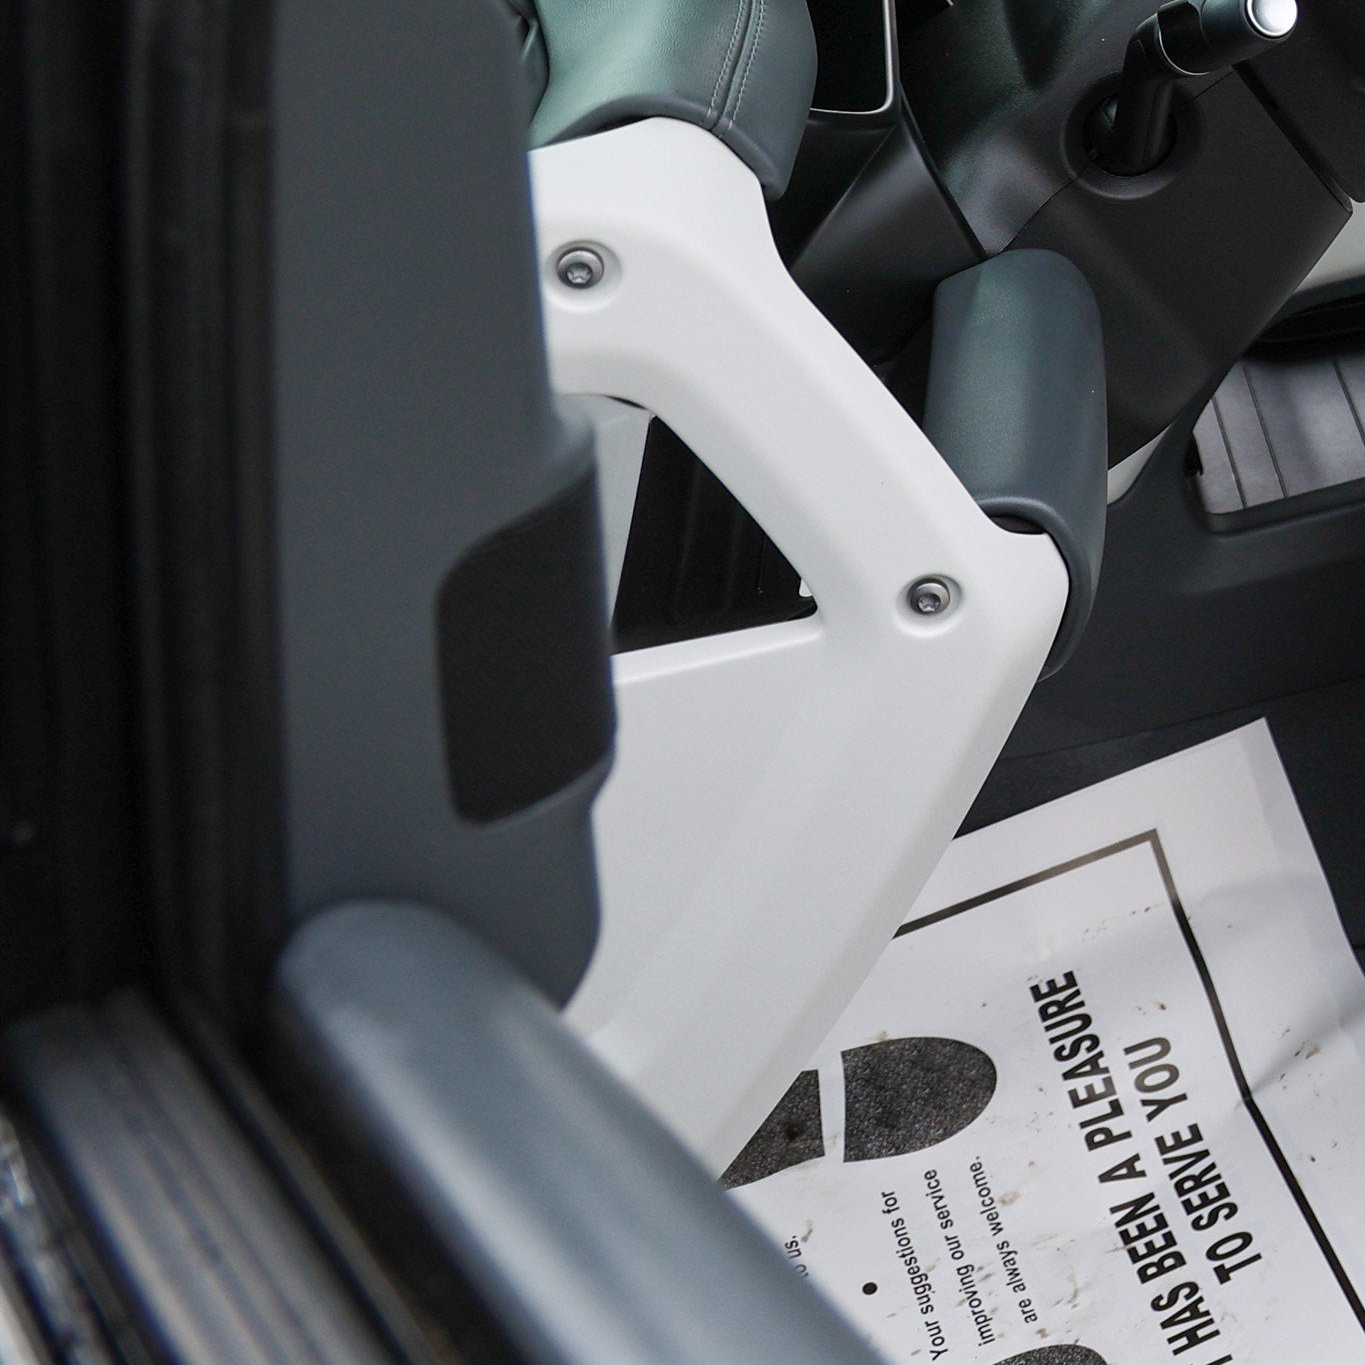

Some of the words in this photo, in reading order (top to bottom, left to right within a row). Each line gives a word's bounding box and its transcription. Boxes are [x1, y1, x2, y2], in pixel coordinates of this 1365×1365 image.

[1029, 970, 1133, 1152] PLEASURE
[1123, 1037, 1188, 1123] YOU
[969, 1156, 1004, 1236] welcome.
[1098, 1152, 1147, 1184] A
[1155, 1123, 1239, 1232] SERVE
[881, 1191, 900, 1215] for
[924, 1169, 954, 1230] service
[785, 1235, 803, 1259] us.
[891, 1217, 936, 1315] suggestions
[945, 1235, 965, 1261] our
[996, 1240, 1026, 1294] always
[1109, 1191, 1187, 1284] BEEN
[1205, 1231, 1262, 1285] TO
[957, 1264, 996, 1347] improving
[1018, 1299, 1038, 1324] are
[1150, 1280, 1221, 1357] HAS
[925, 1321, 948, 1361] Your
